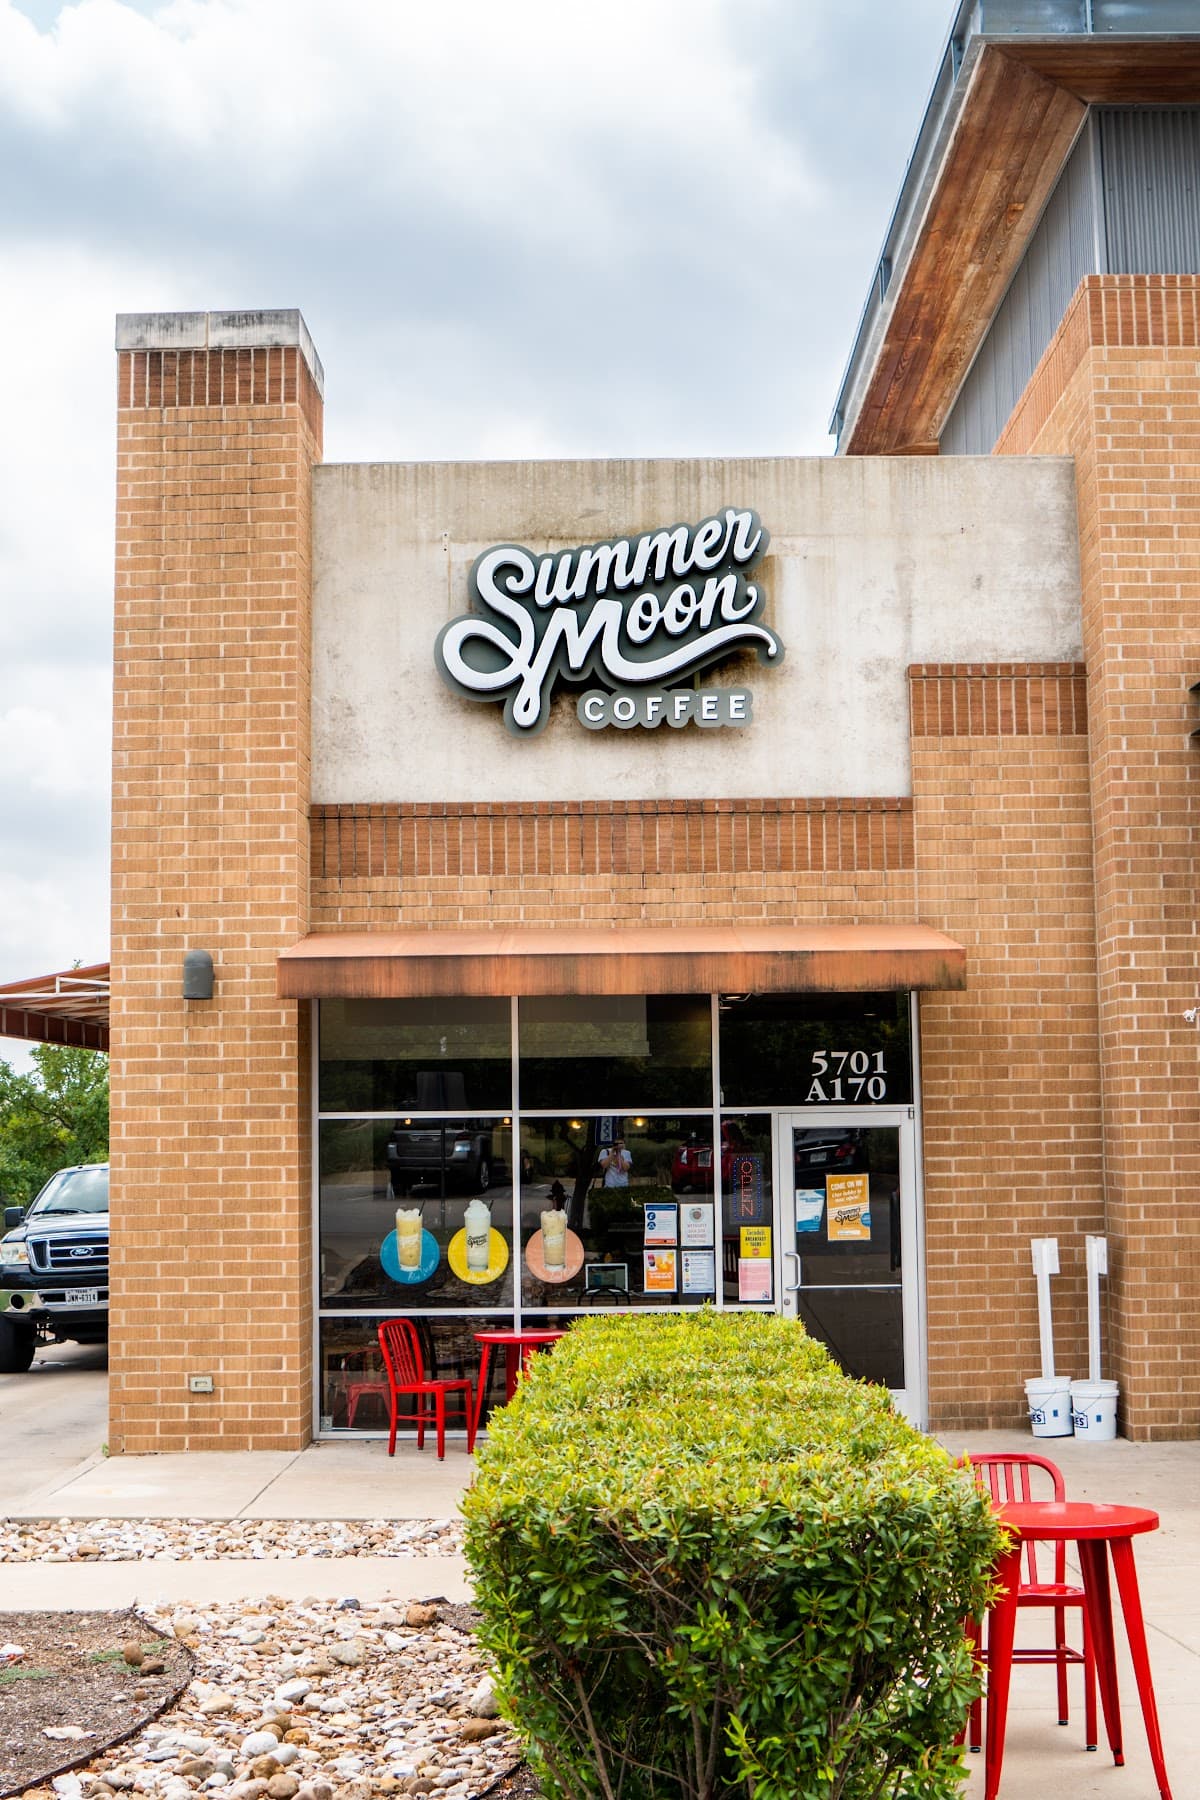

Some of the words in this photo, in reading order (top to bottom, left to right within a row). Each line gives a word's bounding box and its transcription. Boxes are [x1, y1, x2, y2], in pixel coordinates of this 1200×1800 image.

[513, 574, 777, 728] Moon
[584, 695, 746, 722] COFFEE
[811, 1050, 888, 1077] 5701
[804, 1077, 887, 1102] A170
[741, 1161, 753, 1217] OPEN
